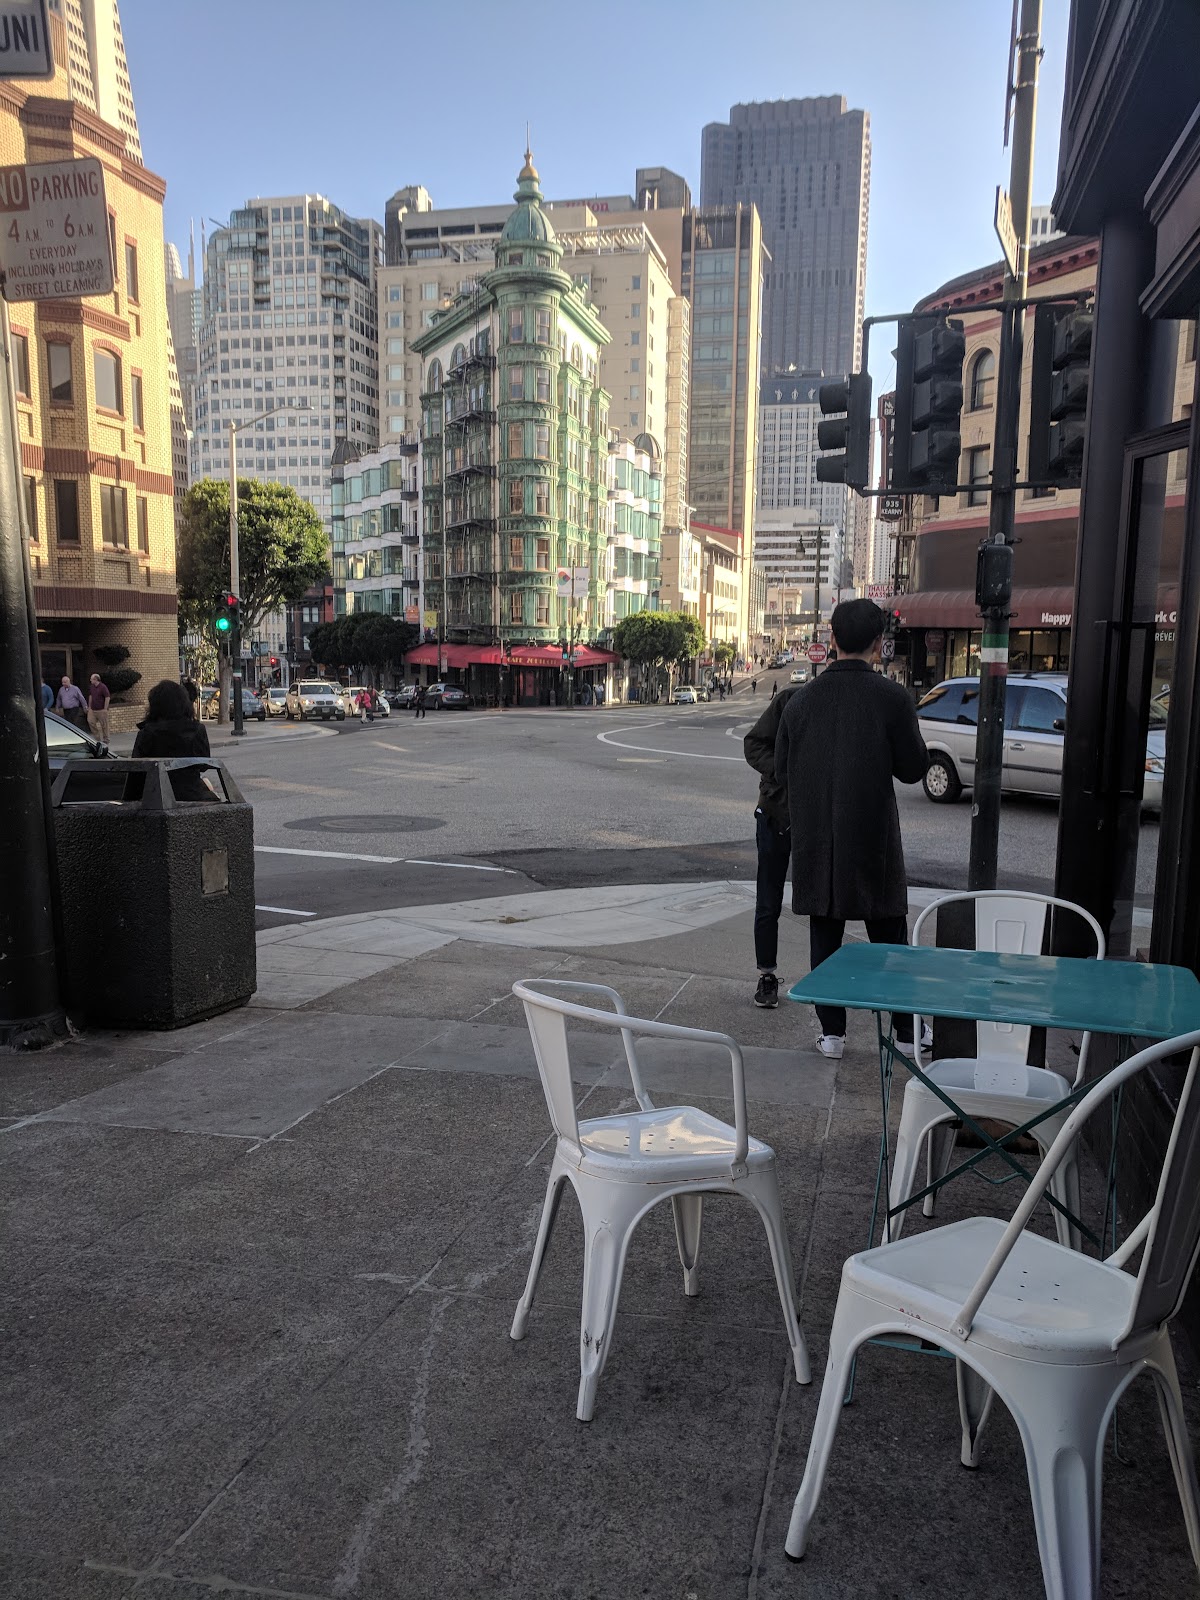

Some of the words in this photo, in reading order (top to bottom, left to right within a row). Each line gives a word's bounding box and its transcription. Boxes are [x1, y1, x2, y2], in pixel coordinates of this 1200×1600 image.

[31, 171, 98, 202] PARKING
[8, 219, 20, 243] 4
[25, 229, 42, 241] A.M.
[46, 219, 54, 229] TO
[64, 213, 75, 238] 6
[79, 223, 96, 237] A.M.
[29, 245, 77, 260] EVERYDAY
[9, 263, 55, 278] INCLUDING
[58, 259, 103, 274] HOLIDAYS
[15, 282, 50, 297] STREET
[54, 278, 101, 294] CLEANING
[881, 508, 903, 516] KEARNY
[885, 500, 900, 508] 935
[1041, 612, 1072, 625] Happy
